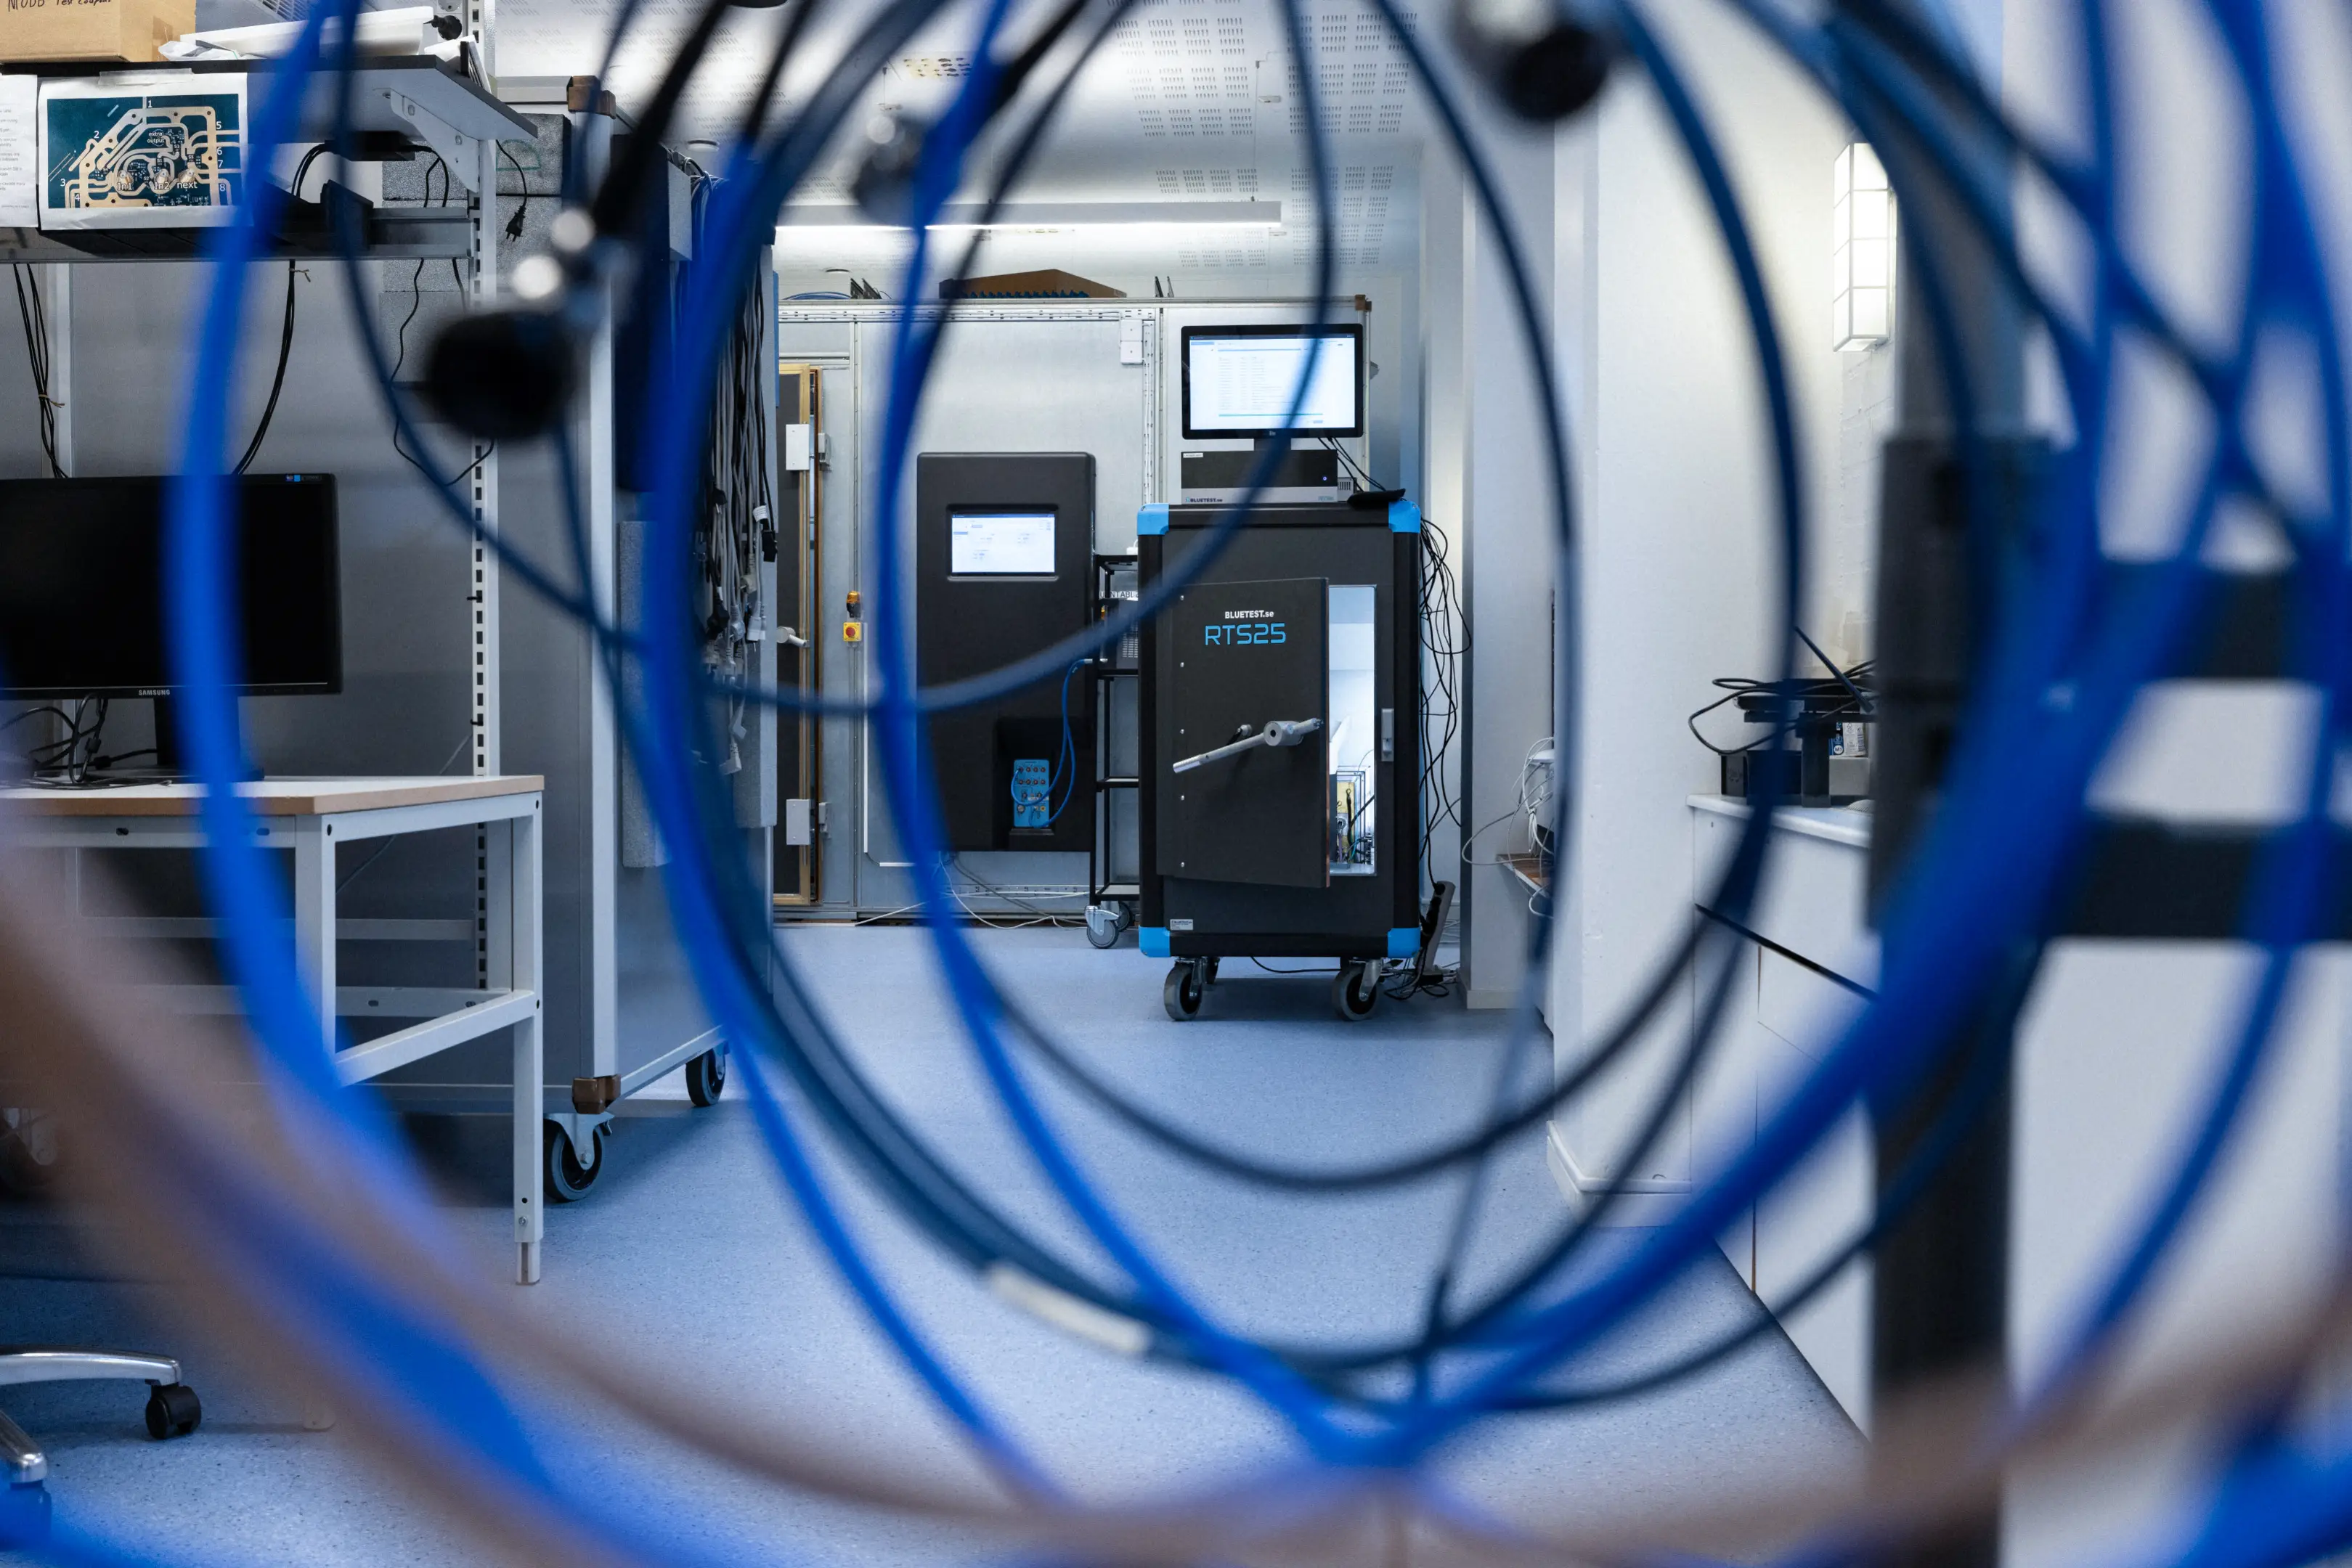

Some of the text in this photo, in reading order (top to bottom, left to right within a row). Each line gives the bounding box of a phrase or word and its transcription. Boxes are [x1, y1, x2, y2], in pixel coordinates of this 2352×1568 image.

[147, 99, 152, 108] 1
[216, 121, 222, 130] 5
[94, 130, 99, 139] 2
[216, 147, 223, 155] 6
[60, 178, 66, 187] 3
[154, 181, 170, 190] In2
[219, 183, 226, 192] 8
[1224, 610, 1274, 619] BLUETEST.se
[1205, 623, 1286, 645] RTS25
